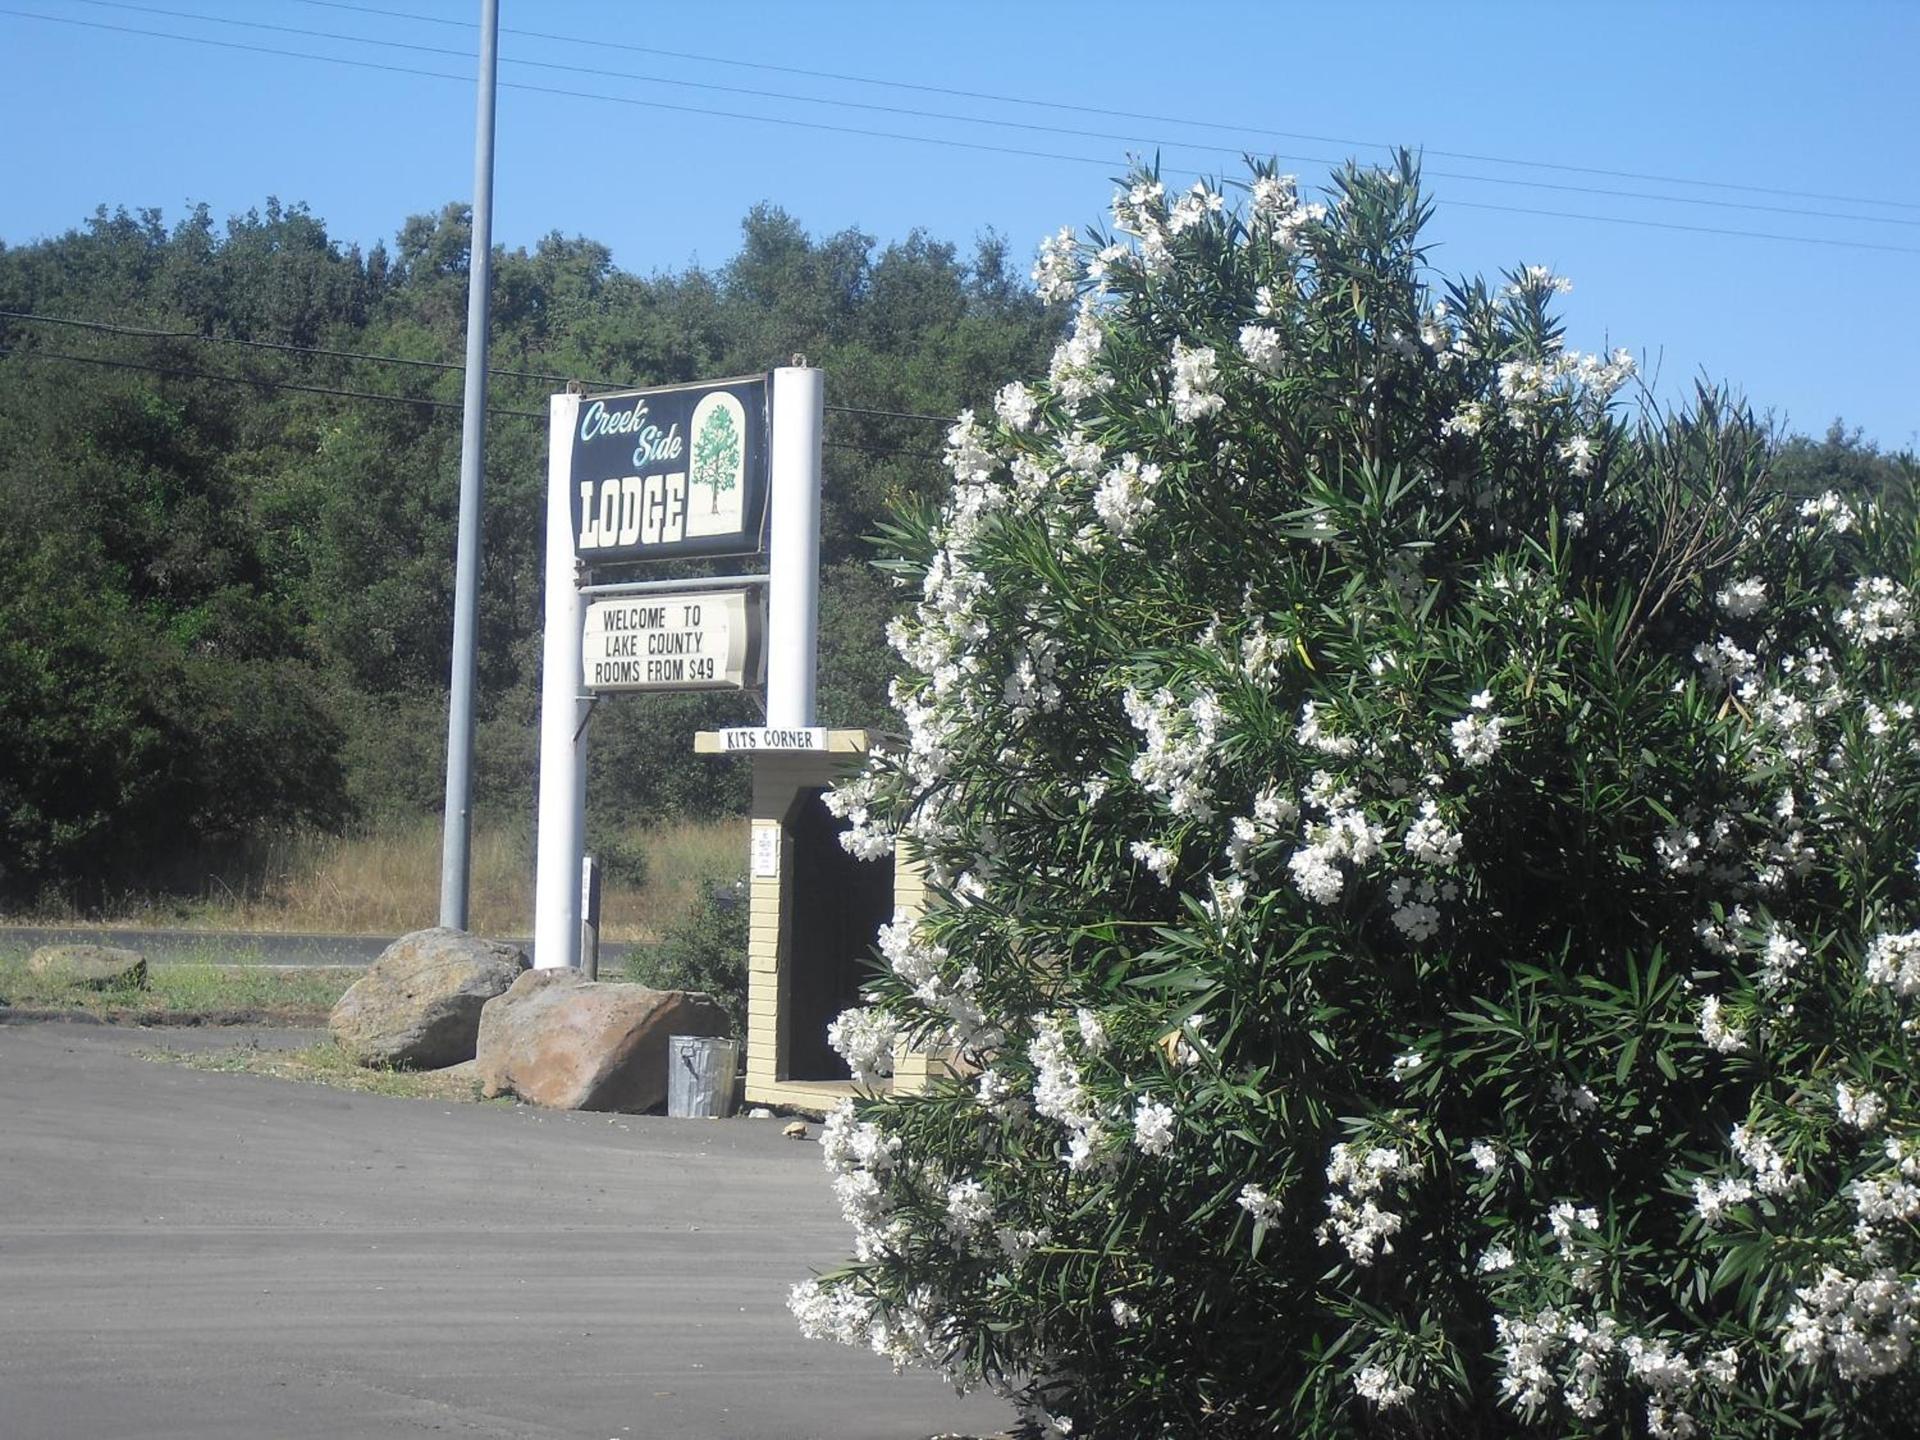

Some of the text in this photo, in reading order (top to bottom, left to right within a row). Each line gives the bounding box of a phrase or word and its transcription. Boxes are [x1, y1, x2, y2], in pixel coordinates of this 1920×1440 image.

[580, 399, 649, 442] Creek
[632, 424, 683, 467] Side
[579, 472, 686, 549] LODGE
[603, 605, 701, 631] WELCOME TO
[605, 632, 703, 657] LAKE COUNTY
[595, 658, 714, 683] ROOMS FROM $49
[727, 730, 814, 749] KITS CORNER
